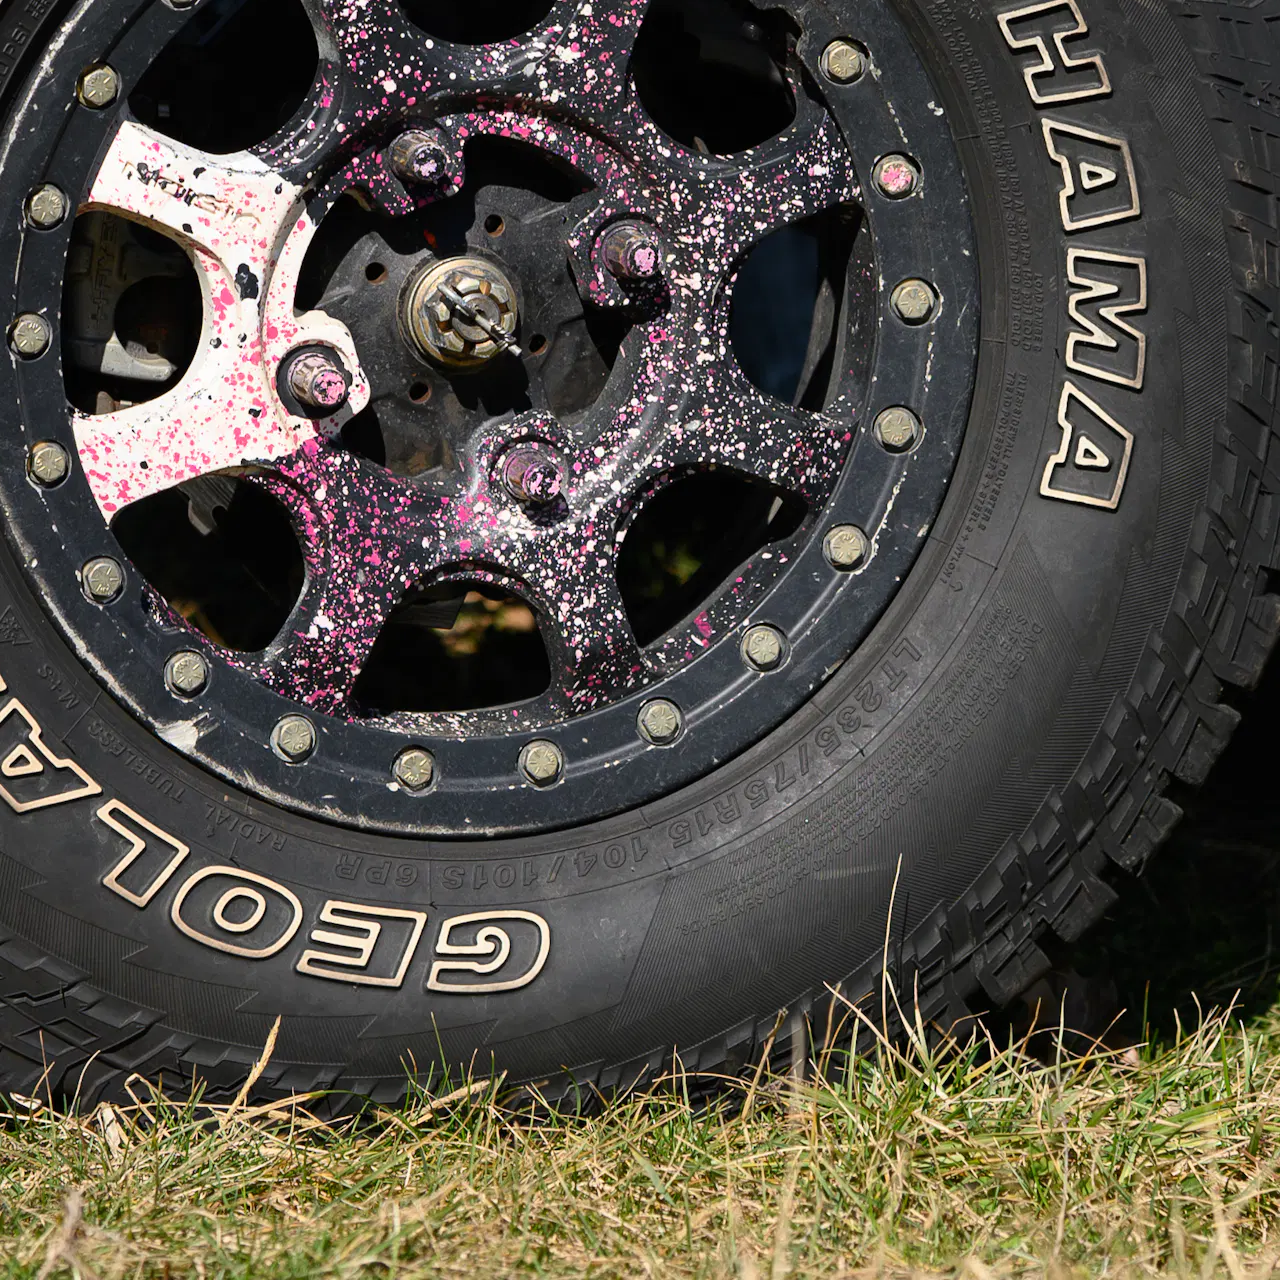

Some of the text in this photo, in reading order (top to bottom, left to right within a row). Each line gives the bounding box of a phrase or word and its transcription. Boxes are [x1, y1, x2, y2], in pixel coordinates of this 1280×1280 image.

[84, 716, 188, 805] TUBELESS
[199, 799, 287, 854] RADIAL
[332, 851, 418, 890] 6PR
